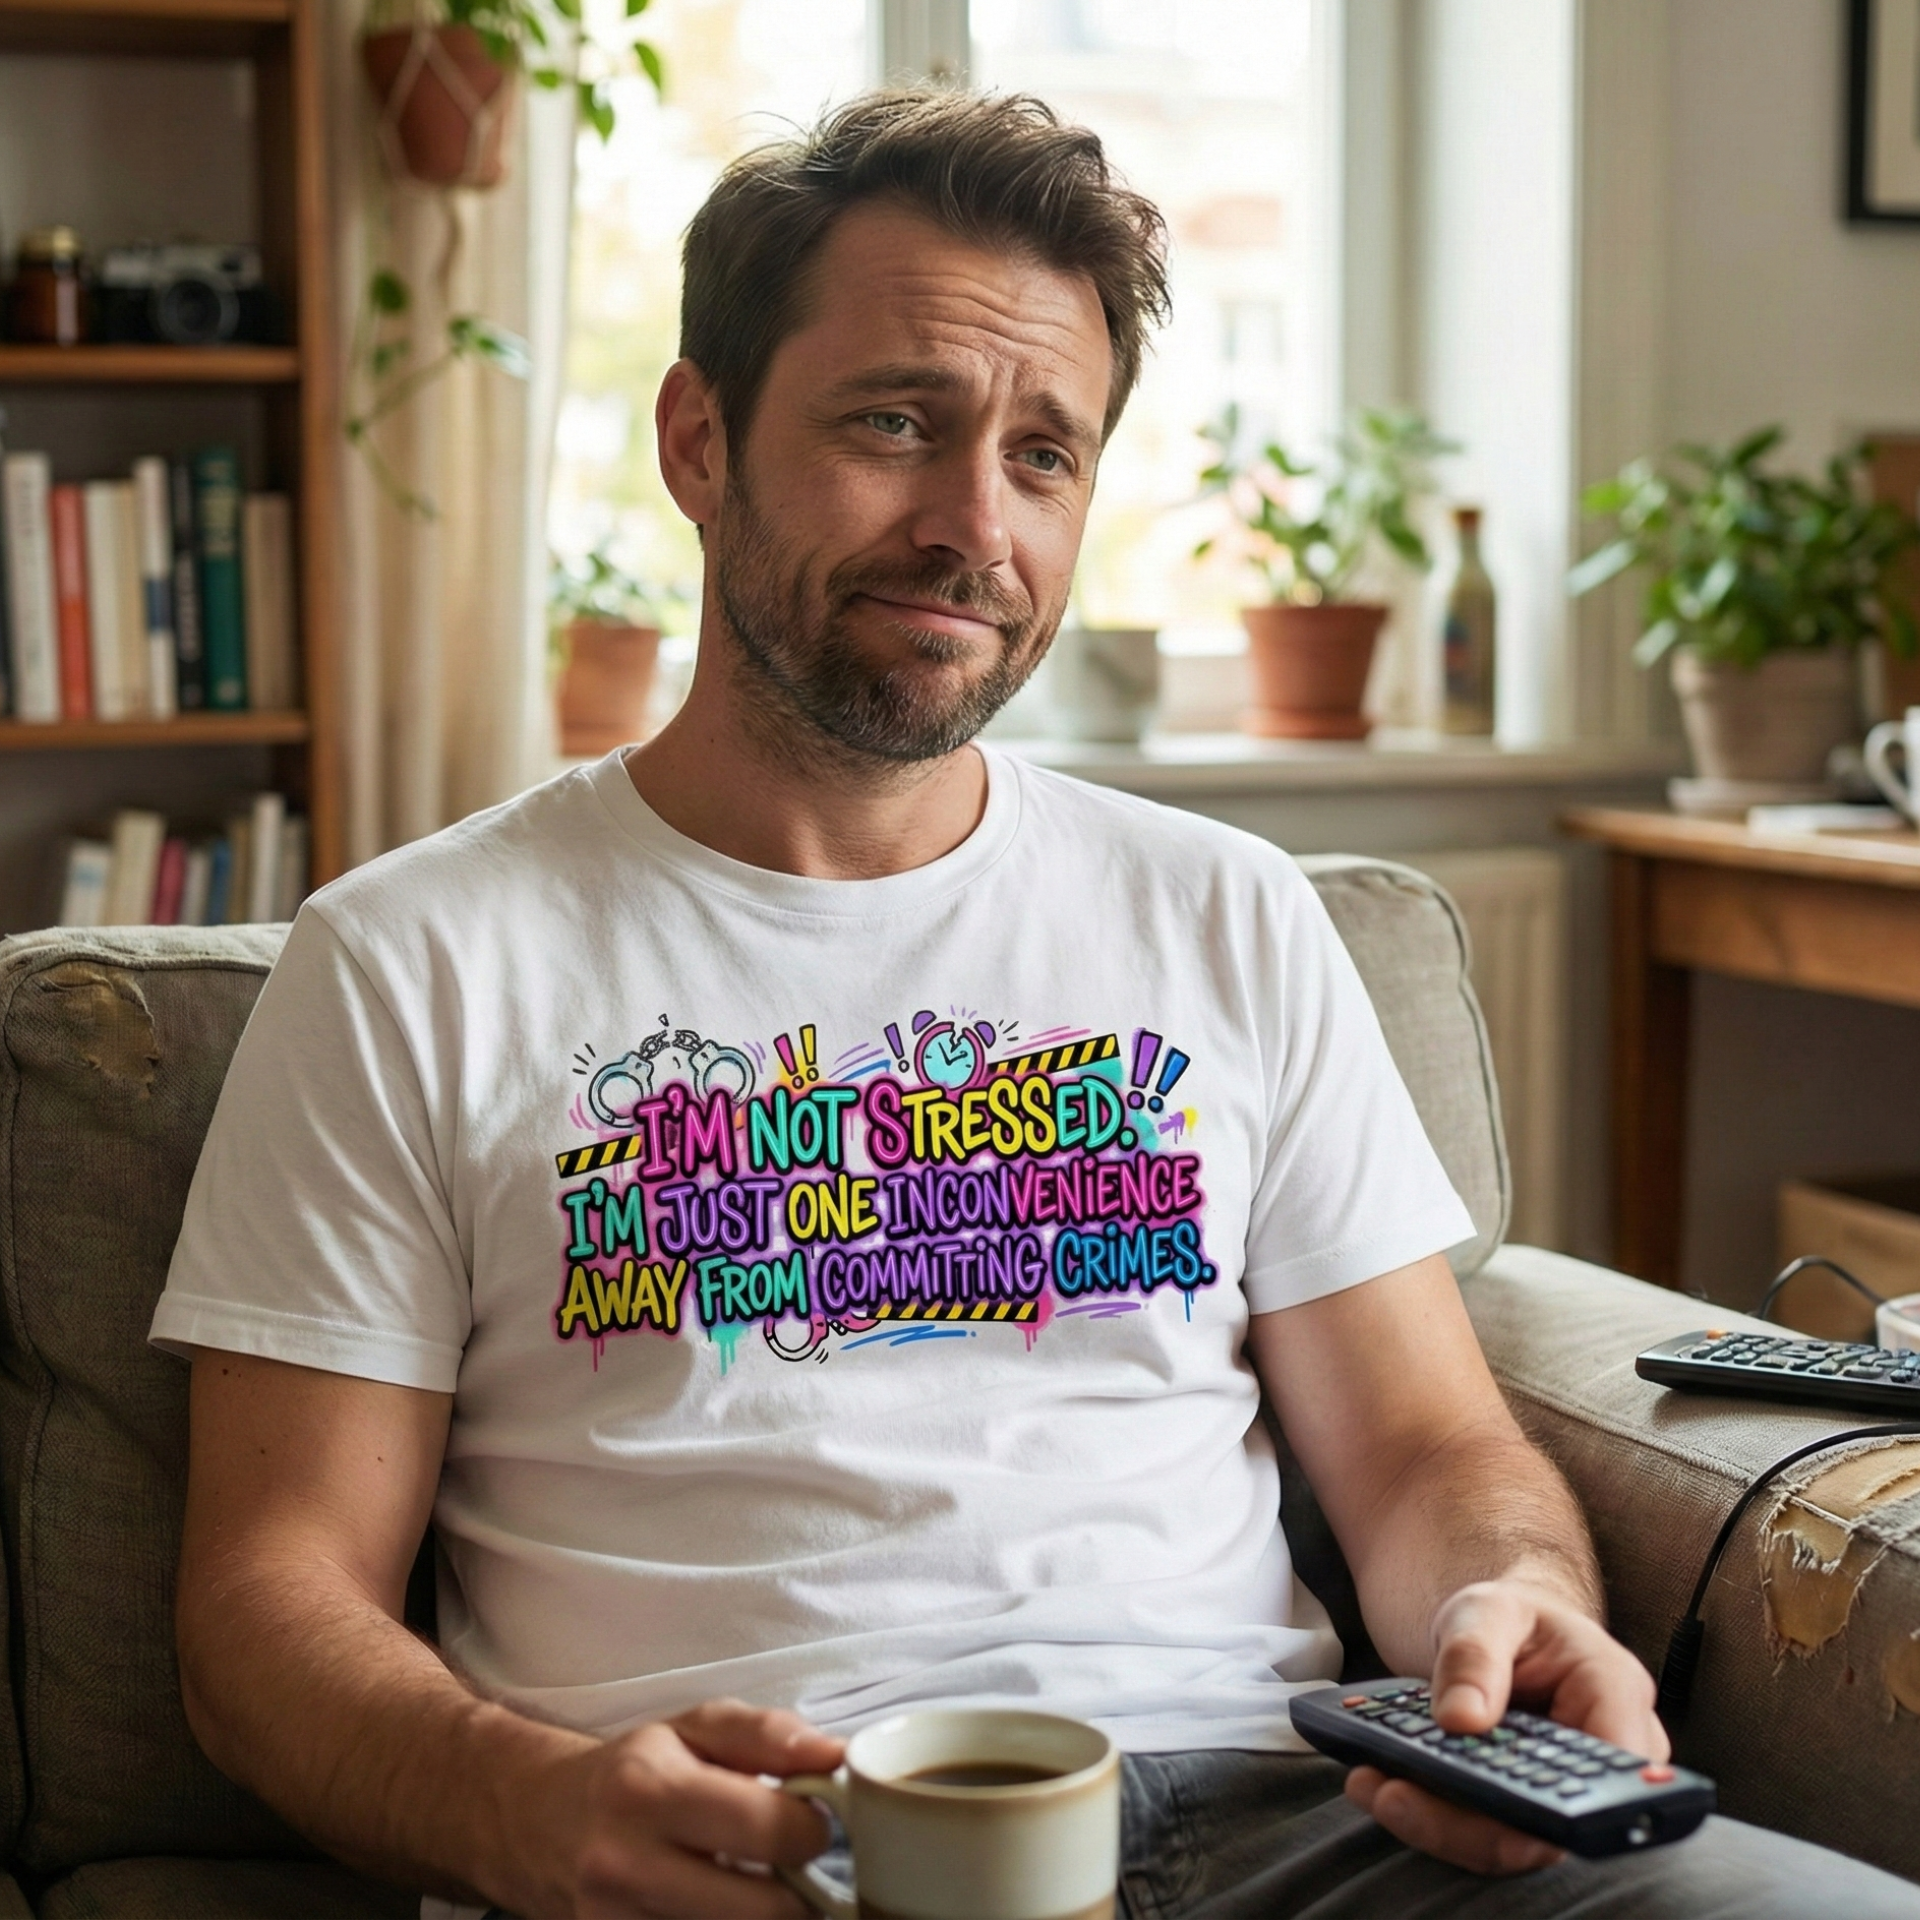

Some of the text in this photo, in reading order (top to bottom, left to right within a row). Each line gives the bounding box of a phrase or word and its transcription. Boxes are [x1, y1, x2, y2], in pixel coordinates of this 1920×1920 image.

[636, 1074, 1137, 1179] I'M NOT STRESSED.
[563, 1178, 648, 1260] I'M
[658, 1178, 782, 1253] JUST
[786, 1170, 880, 1242] ONE
[558, 1258, 690, 1335] AWAY
[695, 1249, 810, 1323] FROM
